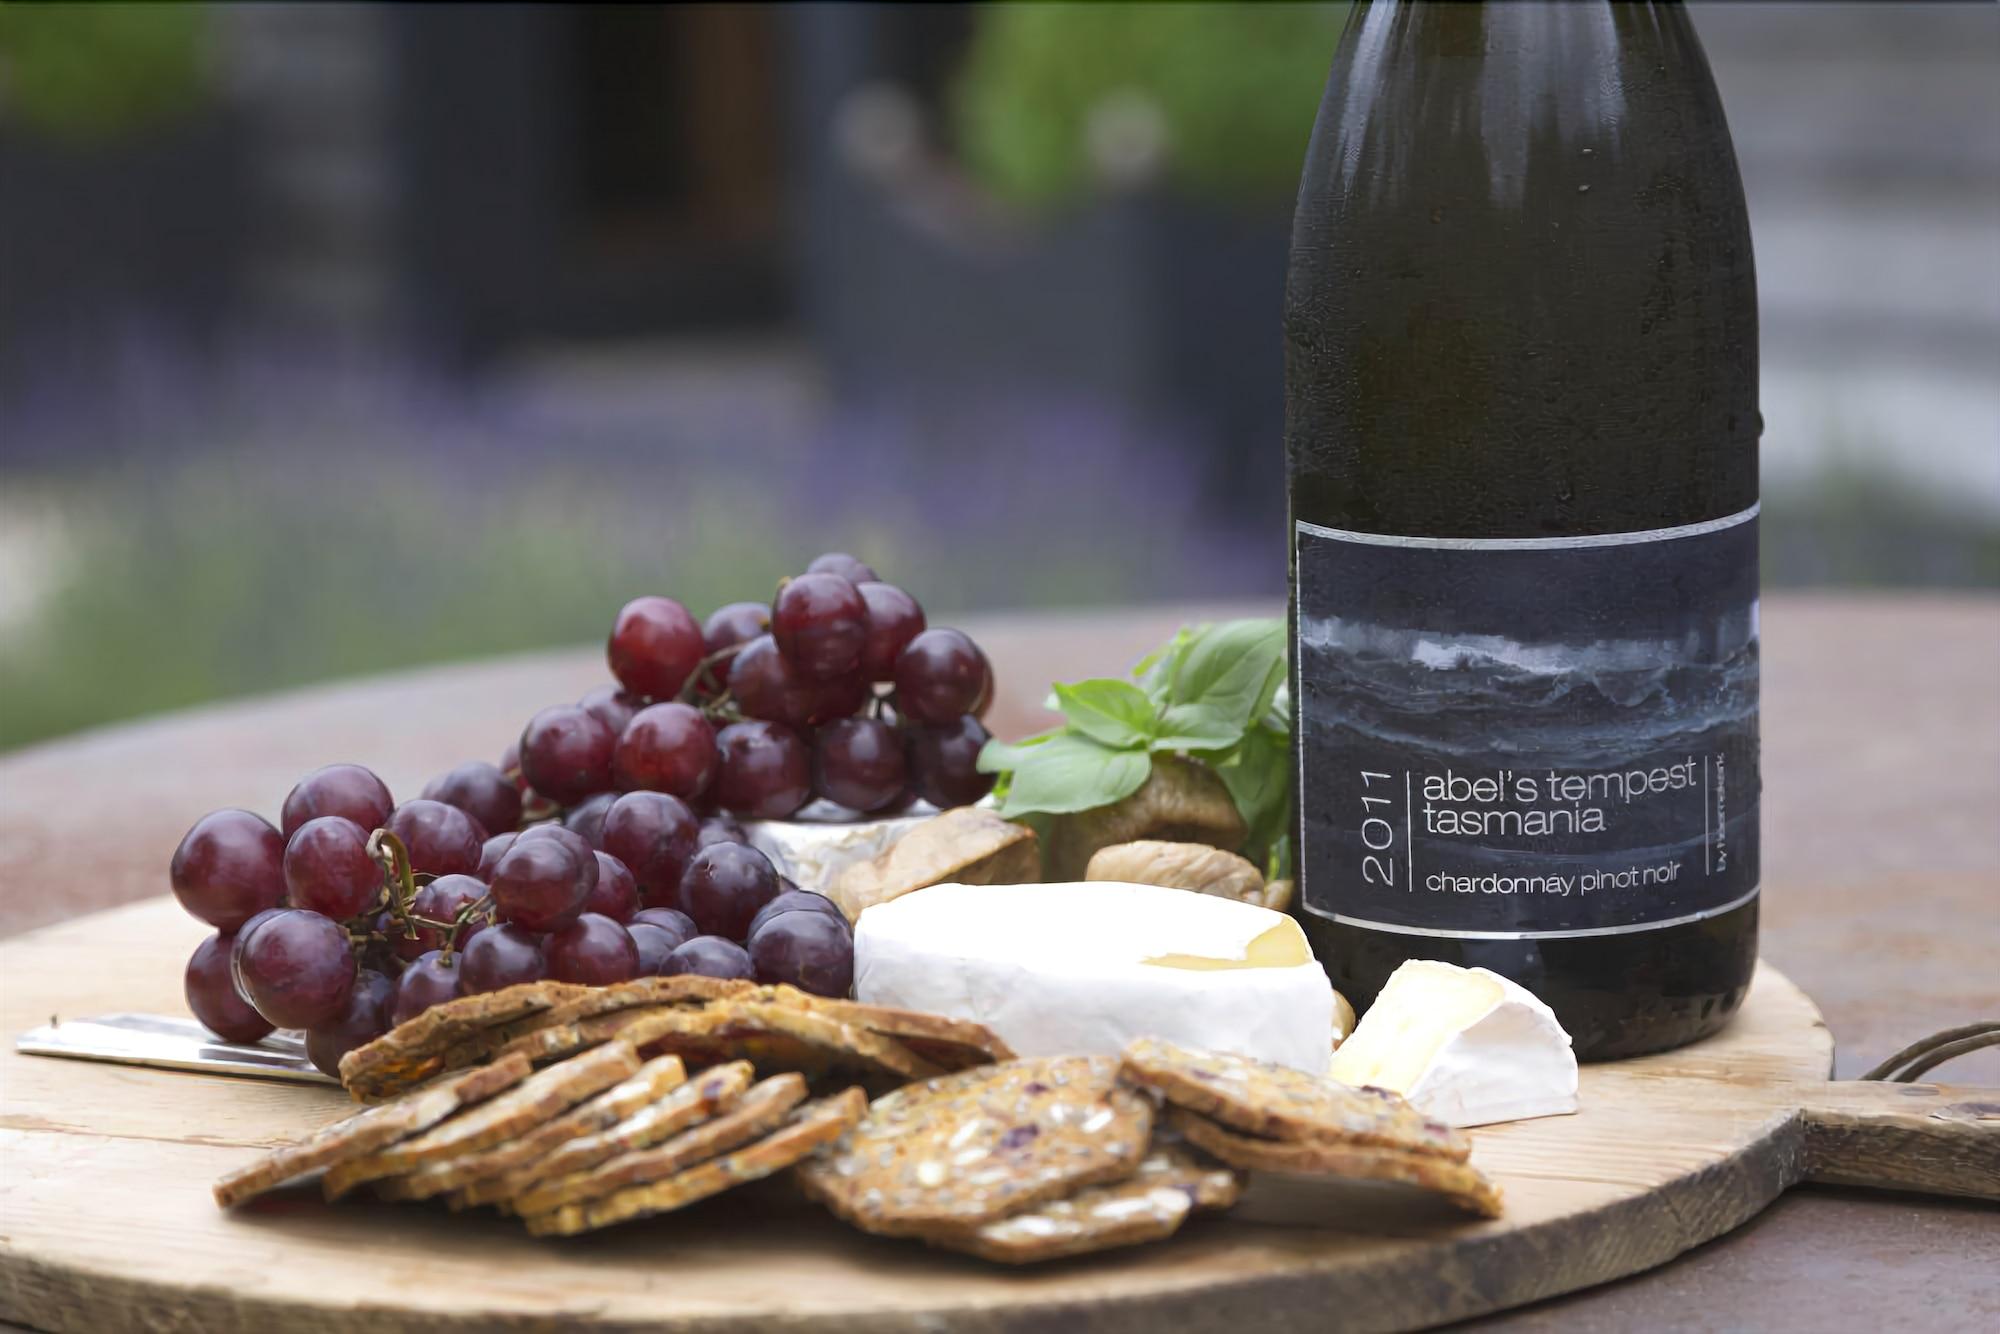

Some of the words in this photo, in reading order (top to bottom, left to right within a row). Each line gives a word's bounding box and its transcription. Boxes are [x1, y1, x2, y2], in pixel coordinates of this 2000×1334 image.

[1422, 769, 1538, 802] abel's
[1546, 756, 1697, 804] tempest
[1361, 770, 1394, 887] 2011
[1423, 801, 1607, 836] tasmania
[1425, 871, 1575, 897] chardonnay
[1580, 867, 1638, 896] pinot
[1642, 861, 1682, 886] noir
